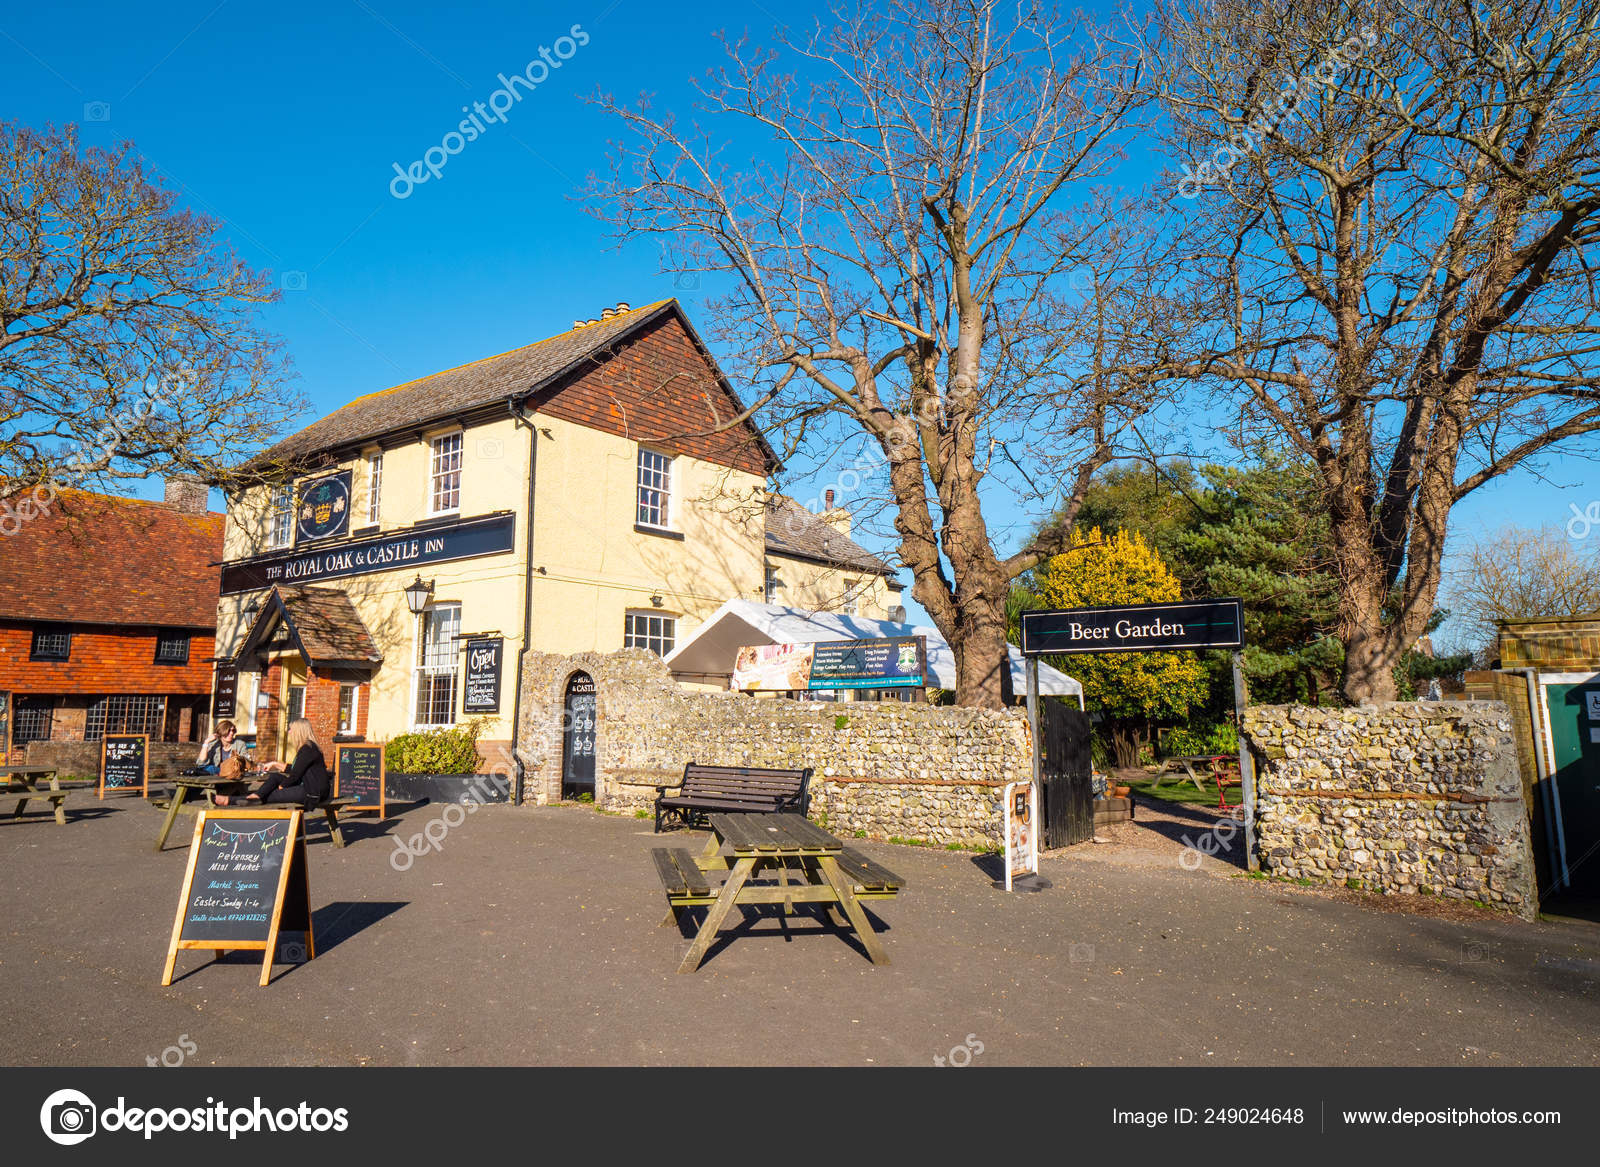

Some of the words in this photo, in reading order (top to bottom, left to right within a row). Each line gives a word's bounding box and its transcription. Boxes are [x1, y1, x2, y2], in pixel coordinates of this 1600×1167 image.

[266, 567, 281, 579] THE
[285, 556, 323, 578] ROYAL
[326, 551, 352, 572] OAK
[356, 552, 364, 566] &
[367, 541, 419, 565] CASTLE
[425, 538, 444, 553] INN
[1069, 623, 1110, 640] Beer
[1115, 618, 1185, 638] Garden
[471, 649, 496, 672] Open
[577, 684, 595, 692] CASTL
[217, 849, 260, 862] Pevensey
[232, 863, 261, 871] Market
[208, 880, 232, 889] Market
[235, 880, 260, 892] Square
[193, 896, 220, 907] Easter
[220, 898, 242, 909] Sunday
